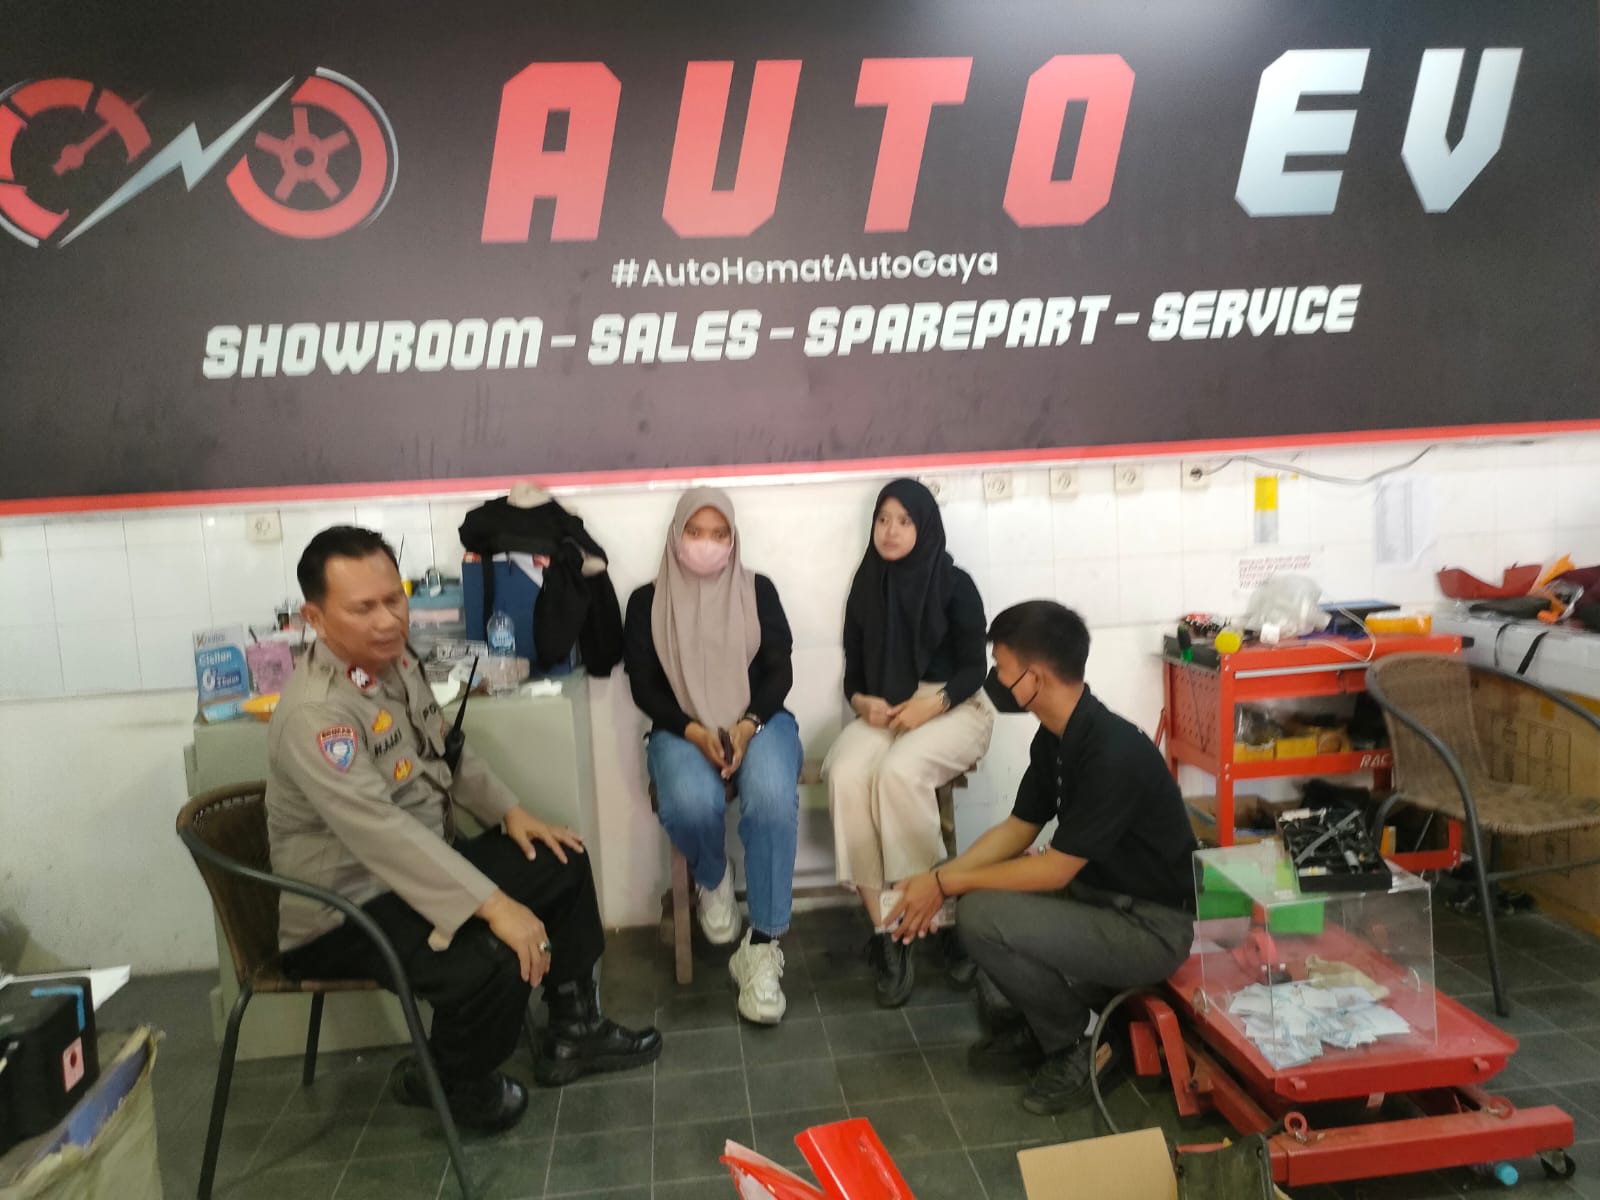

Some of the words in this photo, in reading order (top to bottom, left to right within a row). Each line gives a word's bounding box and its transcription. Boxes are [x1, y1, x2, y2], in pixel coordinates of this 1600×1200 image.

[481, 54, 1136, 242] AUTO
[1235, 47, 1524, 217] EV
[610, 249, 999, 289] #AutoHematAutoGaya
[202, 315, 544, 379] SHOWROOM
[587, 308, 763, 366] SALES
[802, 294, 1112, 358] SPAREPART
[1147, 283, 1363, 342] SERVICE
